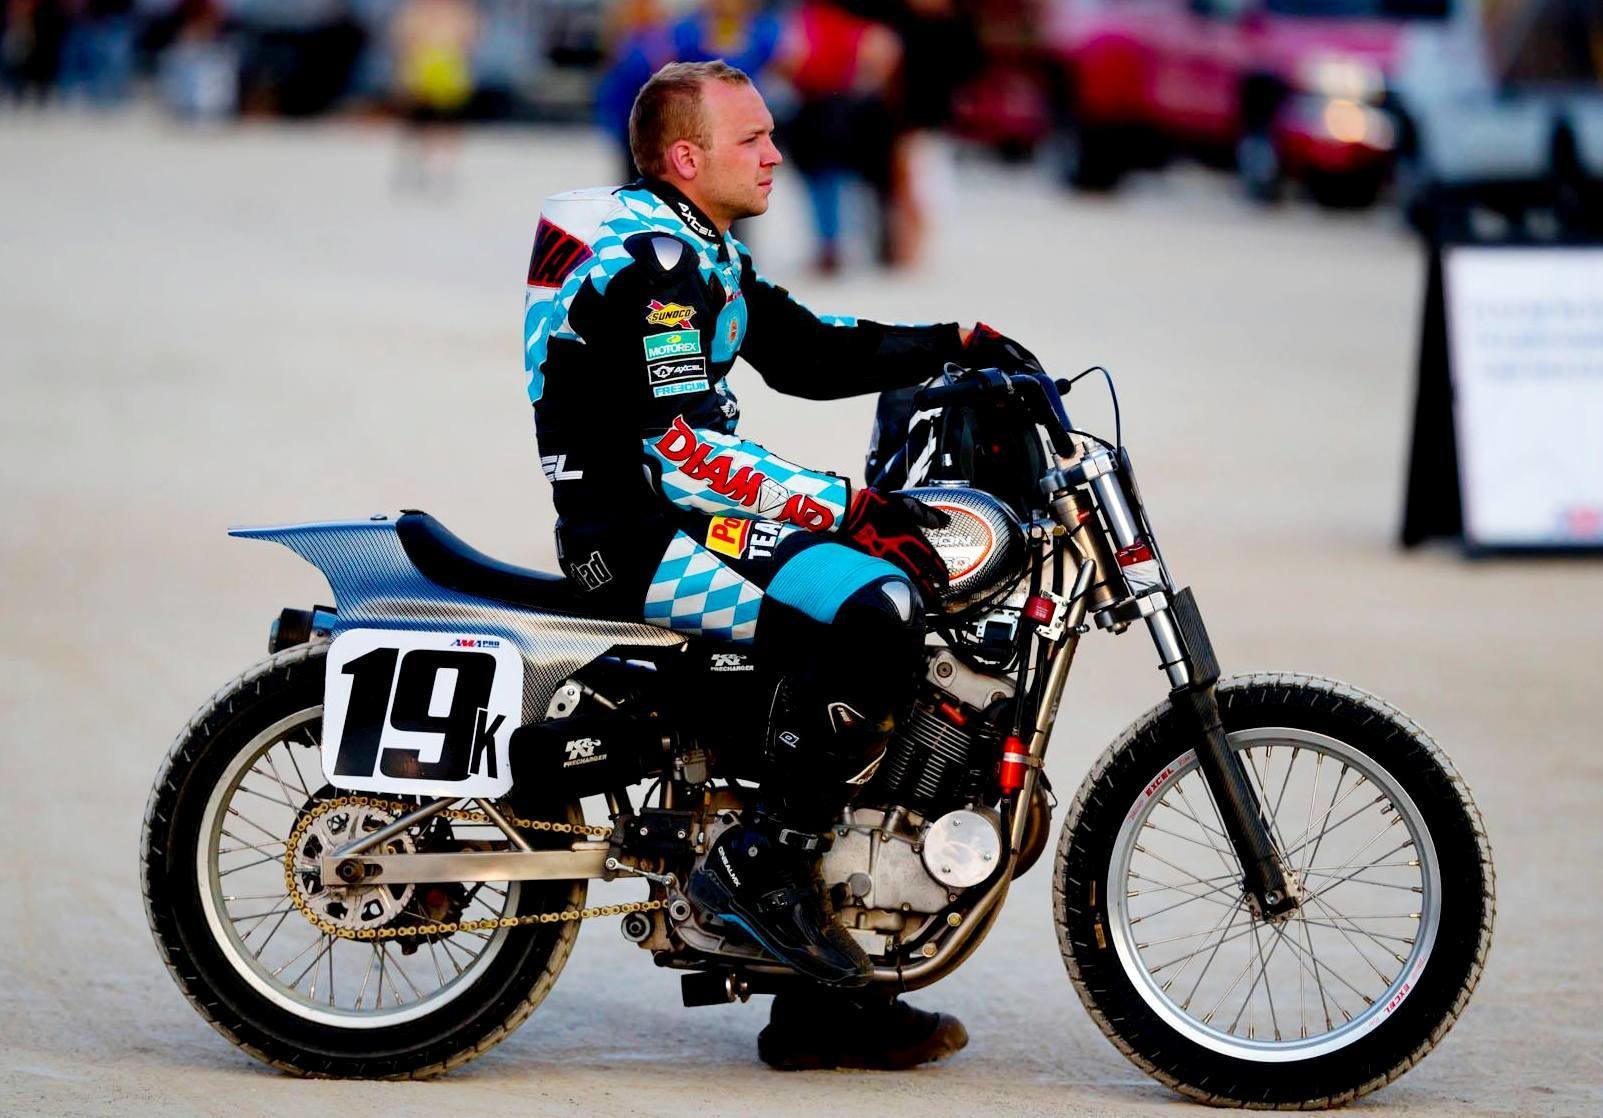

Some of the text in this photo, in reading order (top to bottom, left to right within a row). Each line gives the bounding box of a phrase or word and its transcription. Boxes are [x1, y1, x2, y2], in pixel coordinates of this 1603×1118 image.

[651, 308, 691, 322] SUNOCO
[648, 343, 697, 358] MOTOREX
[1144, 767, 1174, 797] EXCEL
[1382, 982, 1410, 1015] EXCEL
